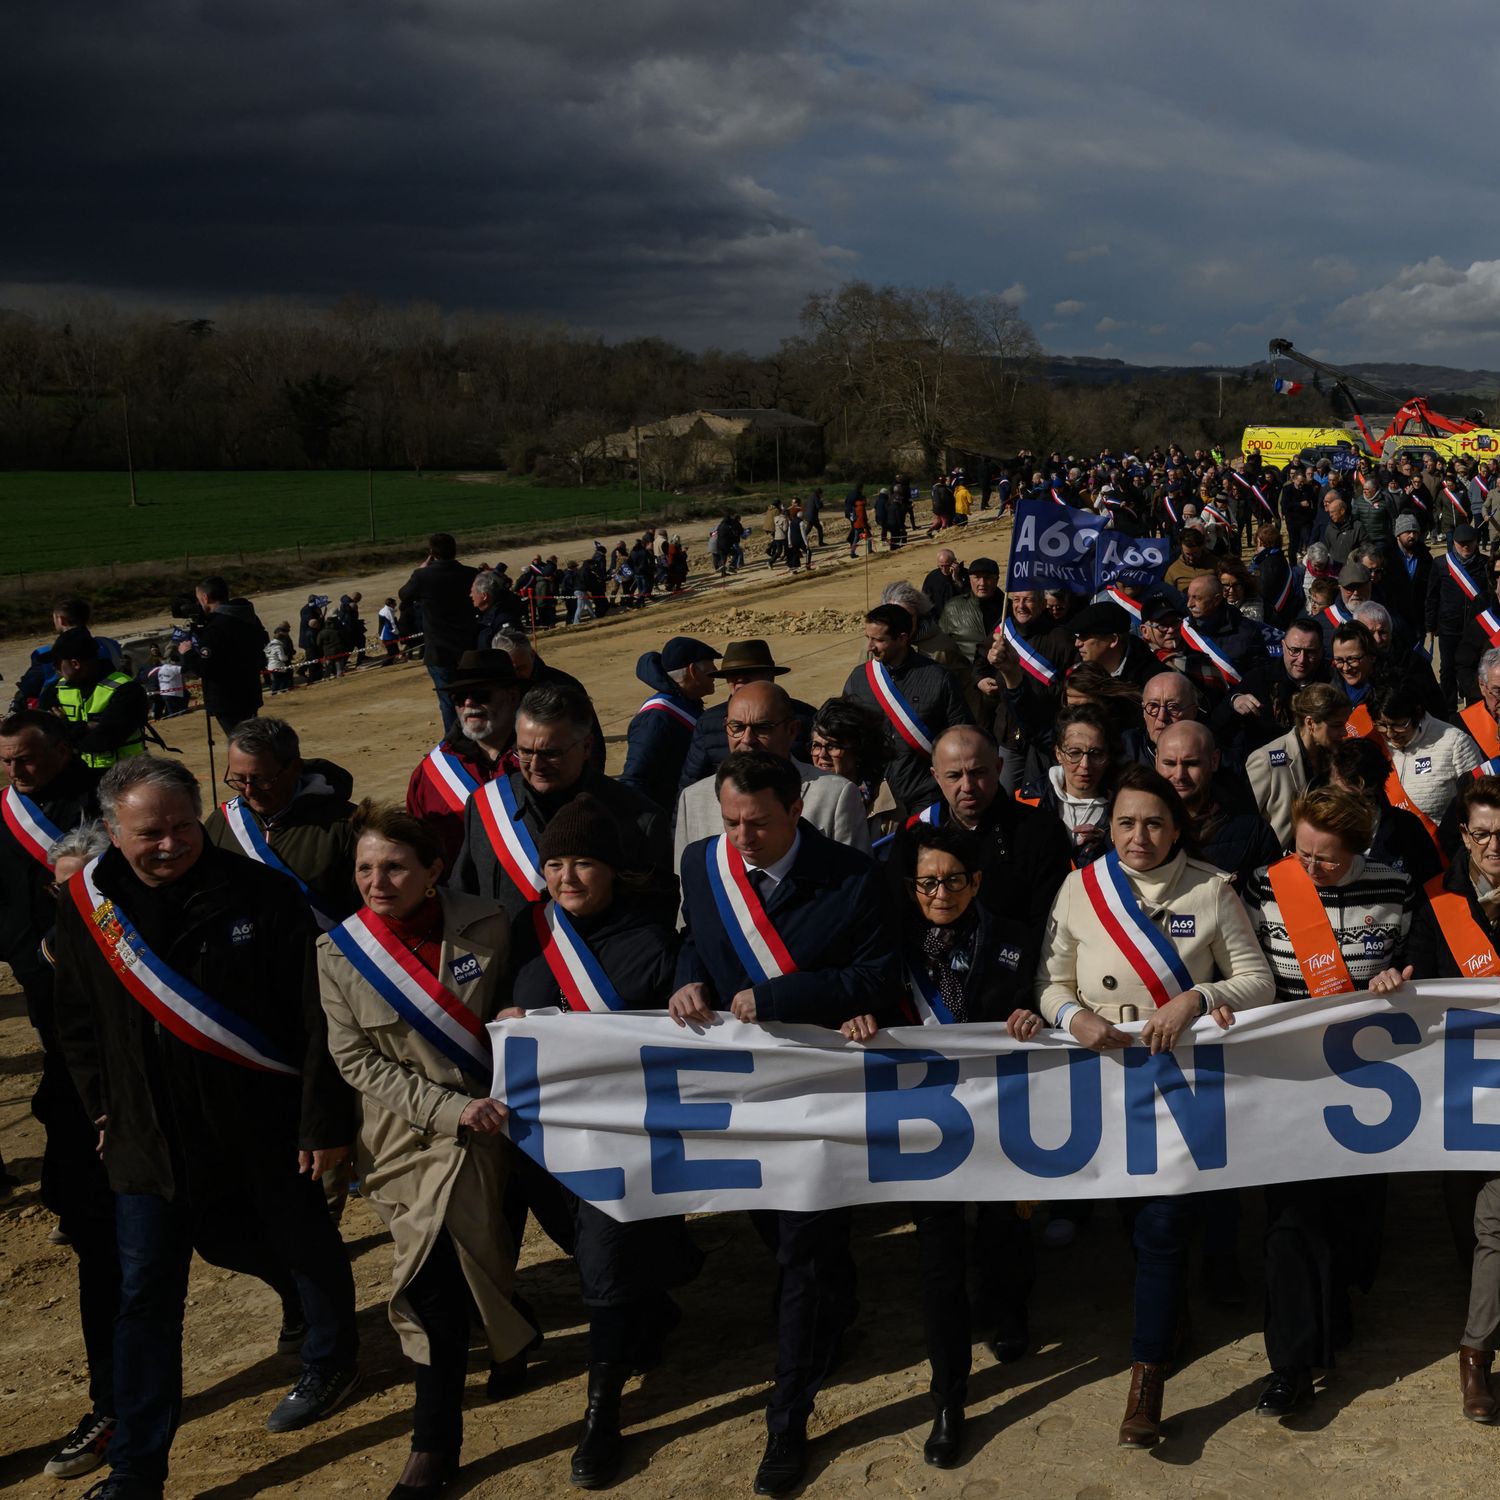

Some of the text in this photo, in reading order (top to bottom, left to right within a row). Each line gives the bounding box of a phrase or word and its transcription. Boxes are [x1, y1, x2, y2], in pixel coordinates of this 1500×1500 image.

[1247, 440, 1272, 449] POLO
[1460, 437, 1498, 452] POO
[1015, 515, 1099, 562] A69
[1102, 540, 1163, 569] A69
[1013, 561, 1029, 578] ON
[1033, 561, 1076, 581] FINIT
[1271, 752, 1286, 760] A69
[1415, 761, 1430, 769] A69
[1171, 920, 1194, 929] A69
[1365, 941, 1384, 950] A69
[1000, 948, 1020, 962] A69
[1303, 950, 1335, 972] TARN
[1462, 950, 1493, 973] TARN
[453, 959, 477, 976] A69
[505, 1037, 762, 1202] LE
